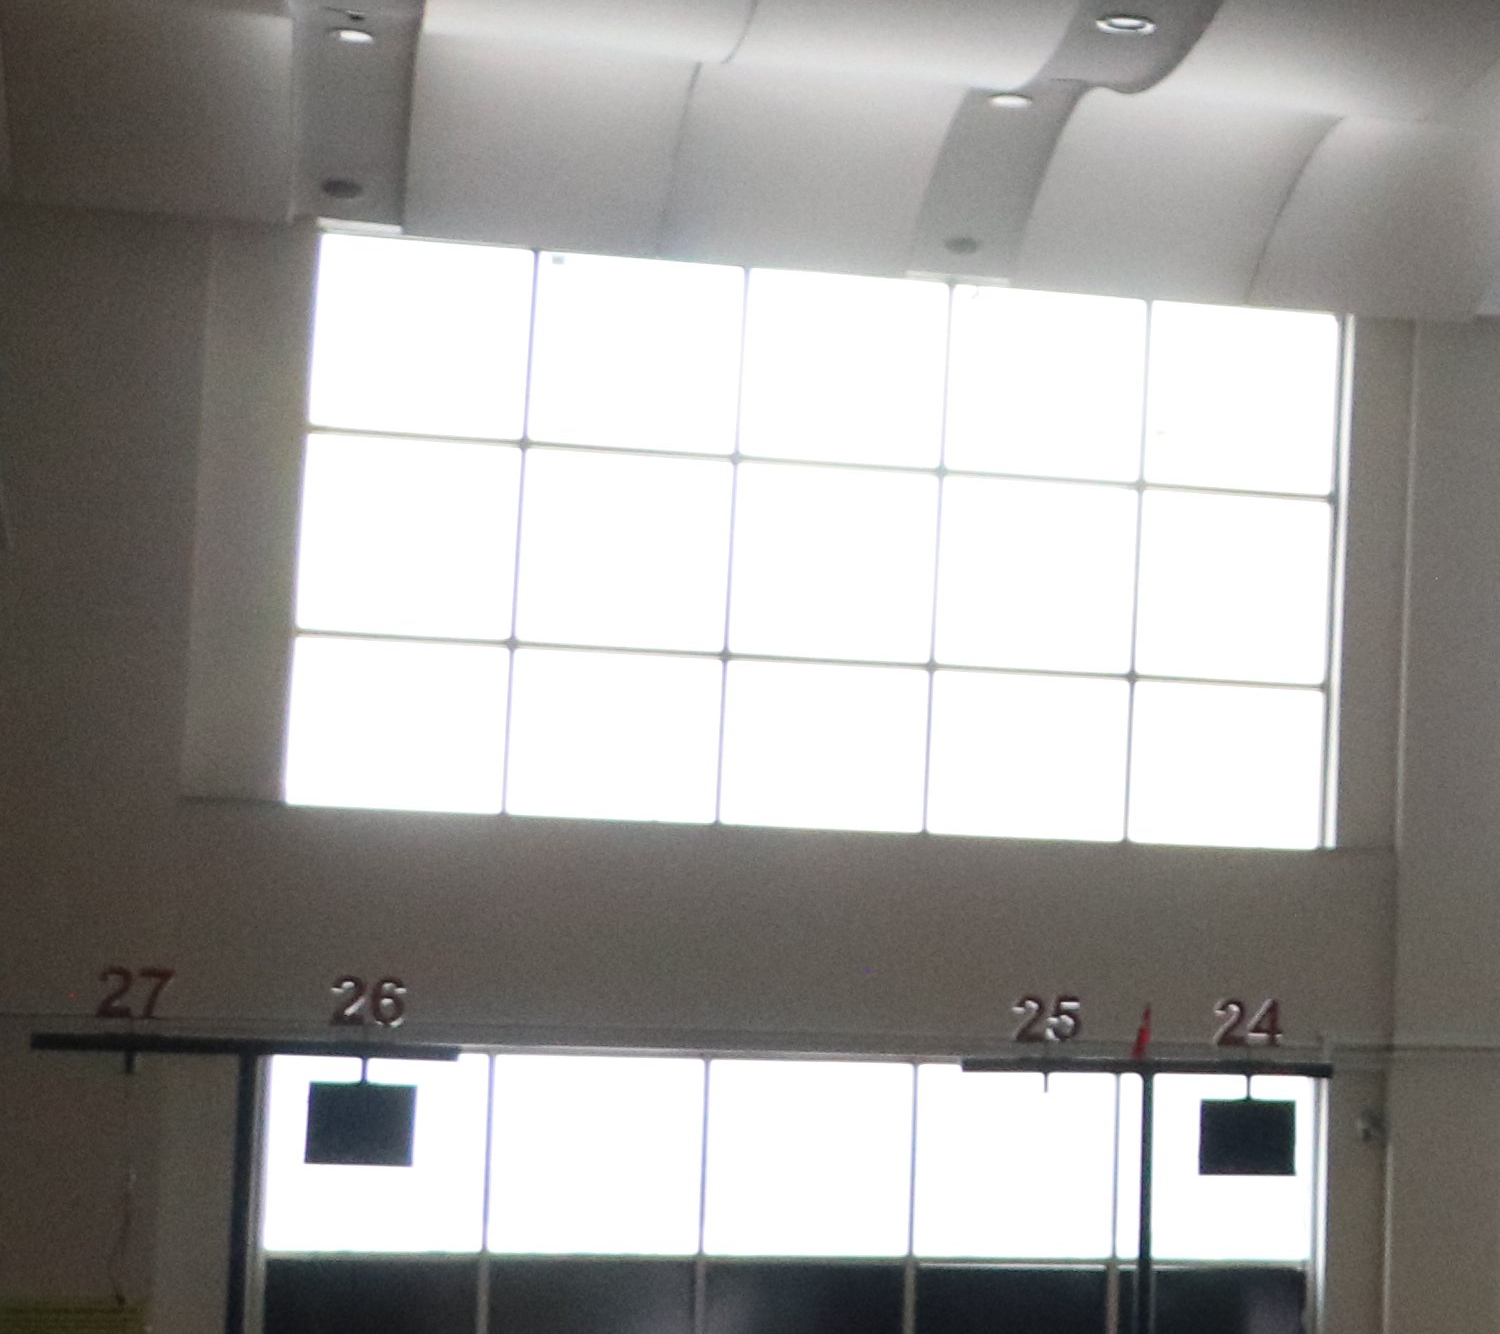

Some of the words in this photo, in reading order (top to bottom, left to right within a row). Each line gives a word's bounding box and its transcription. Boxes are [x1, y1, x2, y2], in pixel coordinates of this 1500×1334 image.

[96, 966, 175, 1020] 27
[329, 974, 408, 1028] 26
[1012, 993, 1083, 1043] 25
[1213, 997, 1284, 1047] 24
